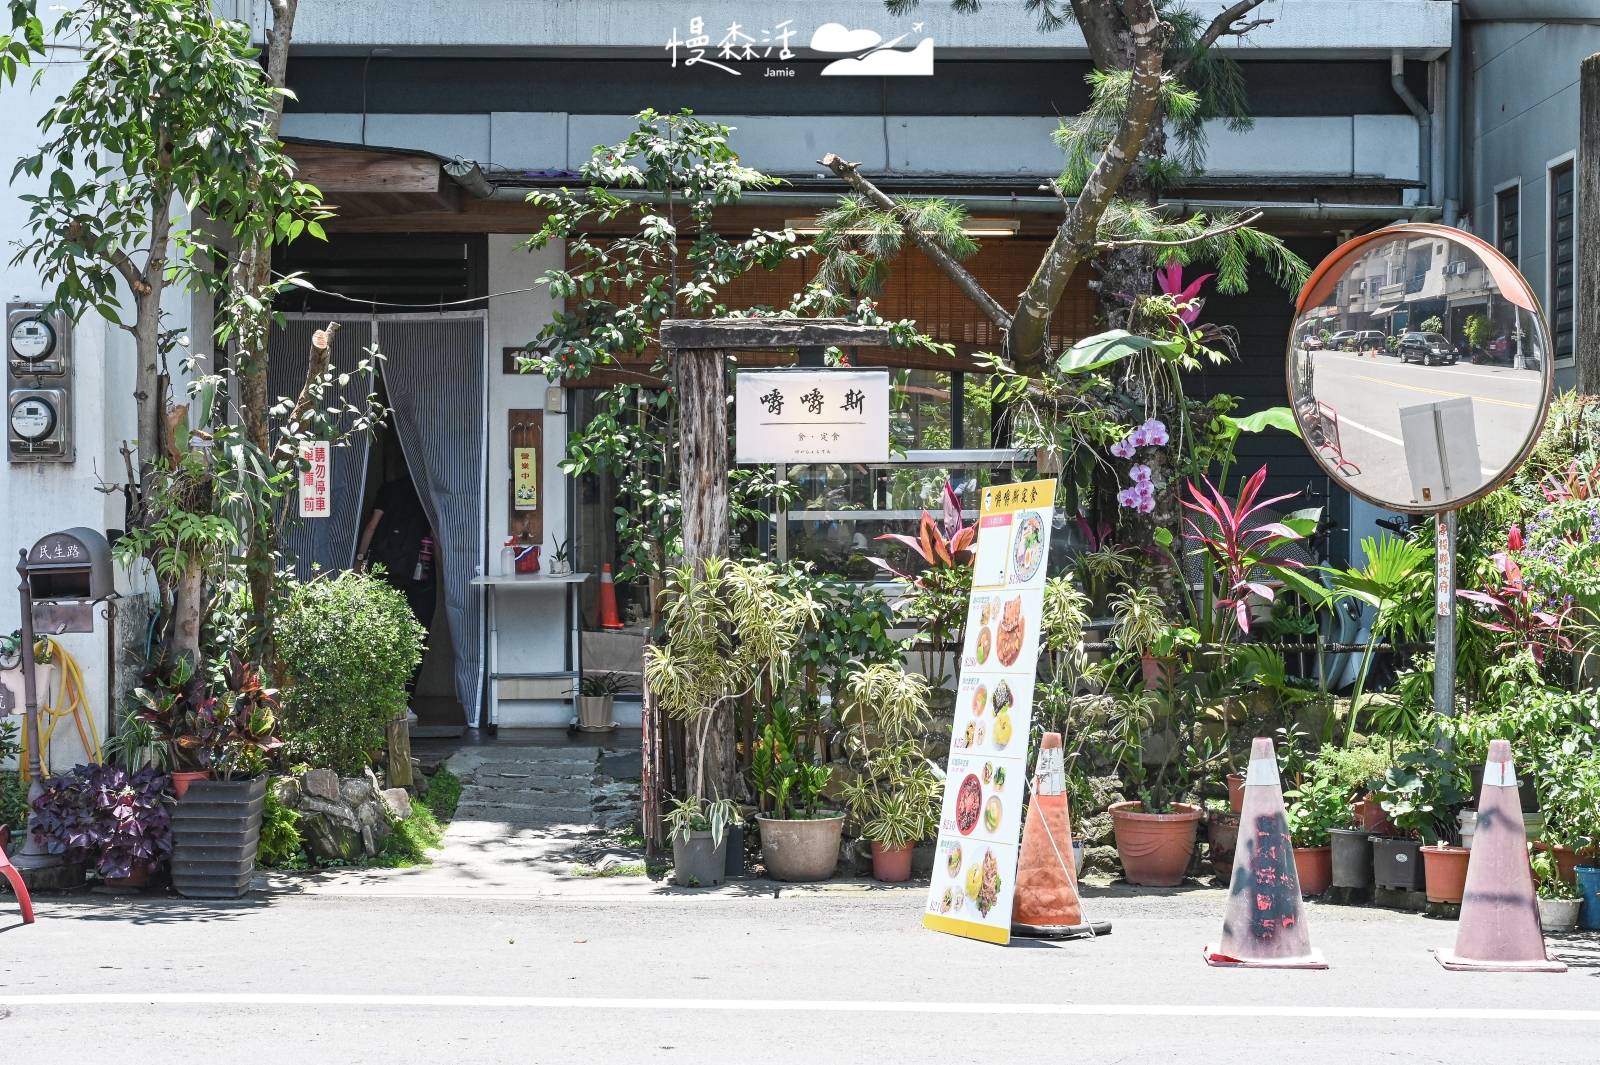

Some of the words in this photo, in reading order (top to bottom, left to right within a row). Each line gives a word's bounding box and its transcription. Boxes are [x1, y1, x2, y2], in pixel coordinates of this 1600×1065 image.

[315, 447, 326, 512] 請勿停車
[520, 452, 530, 480] 營業中
[39, 541, 80, 560] 民生路
